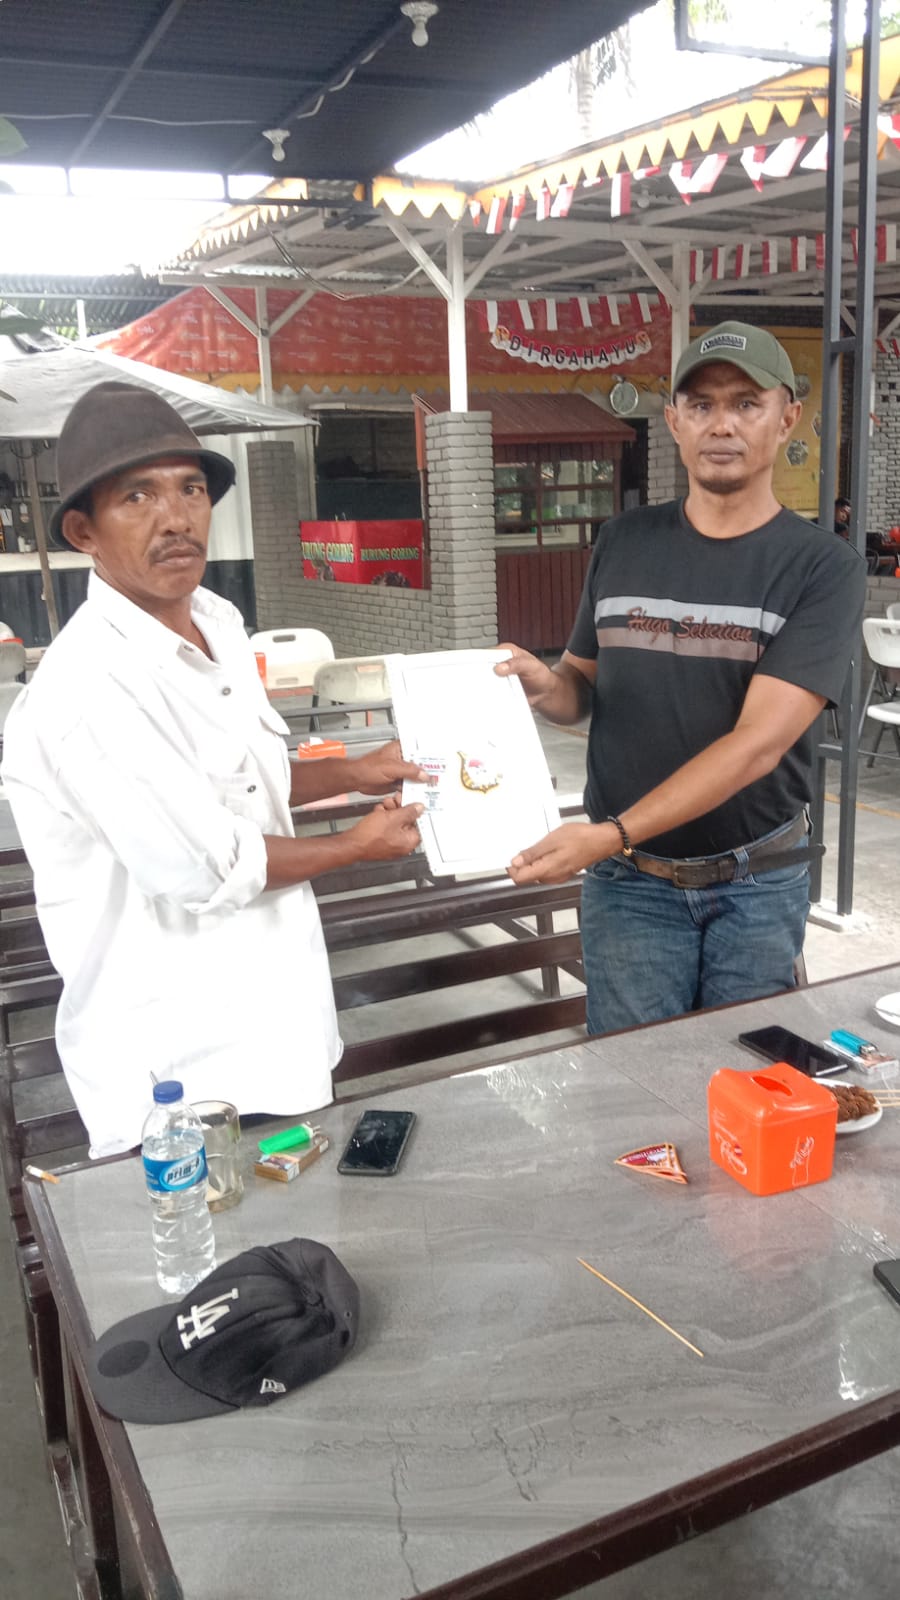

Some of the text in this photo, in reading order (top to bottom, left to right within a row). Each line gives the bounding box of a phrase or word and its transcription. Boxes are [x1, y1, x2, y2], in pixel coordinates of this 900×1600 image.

[509, 335, 636, 366] DIRGAHAYU
[626, 606, 752, 643] Hugo Selection
